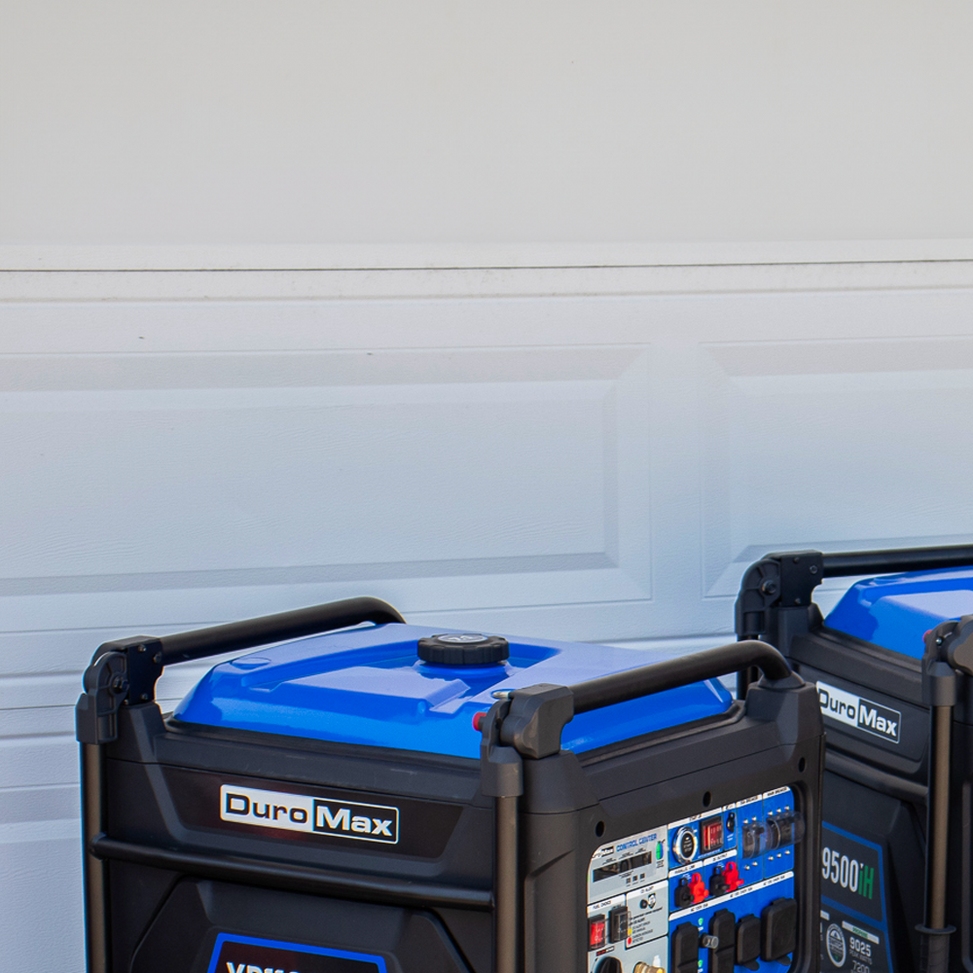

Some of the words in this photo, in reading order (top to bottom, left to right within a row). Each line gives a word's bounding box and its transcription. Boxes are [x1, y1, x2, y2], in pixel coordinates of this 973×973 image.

[225, 792, 393, 837] DuroMax
[821, 847, 875, 899] 9500iH
[849, 936, 872, 957] 9025
